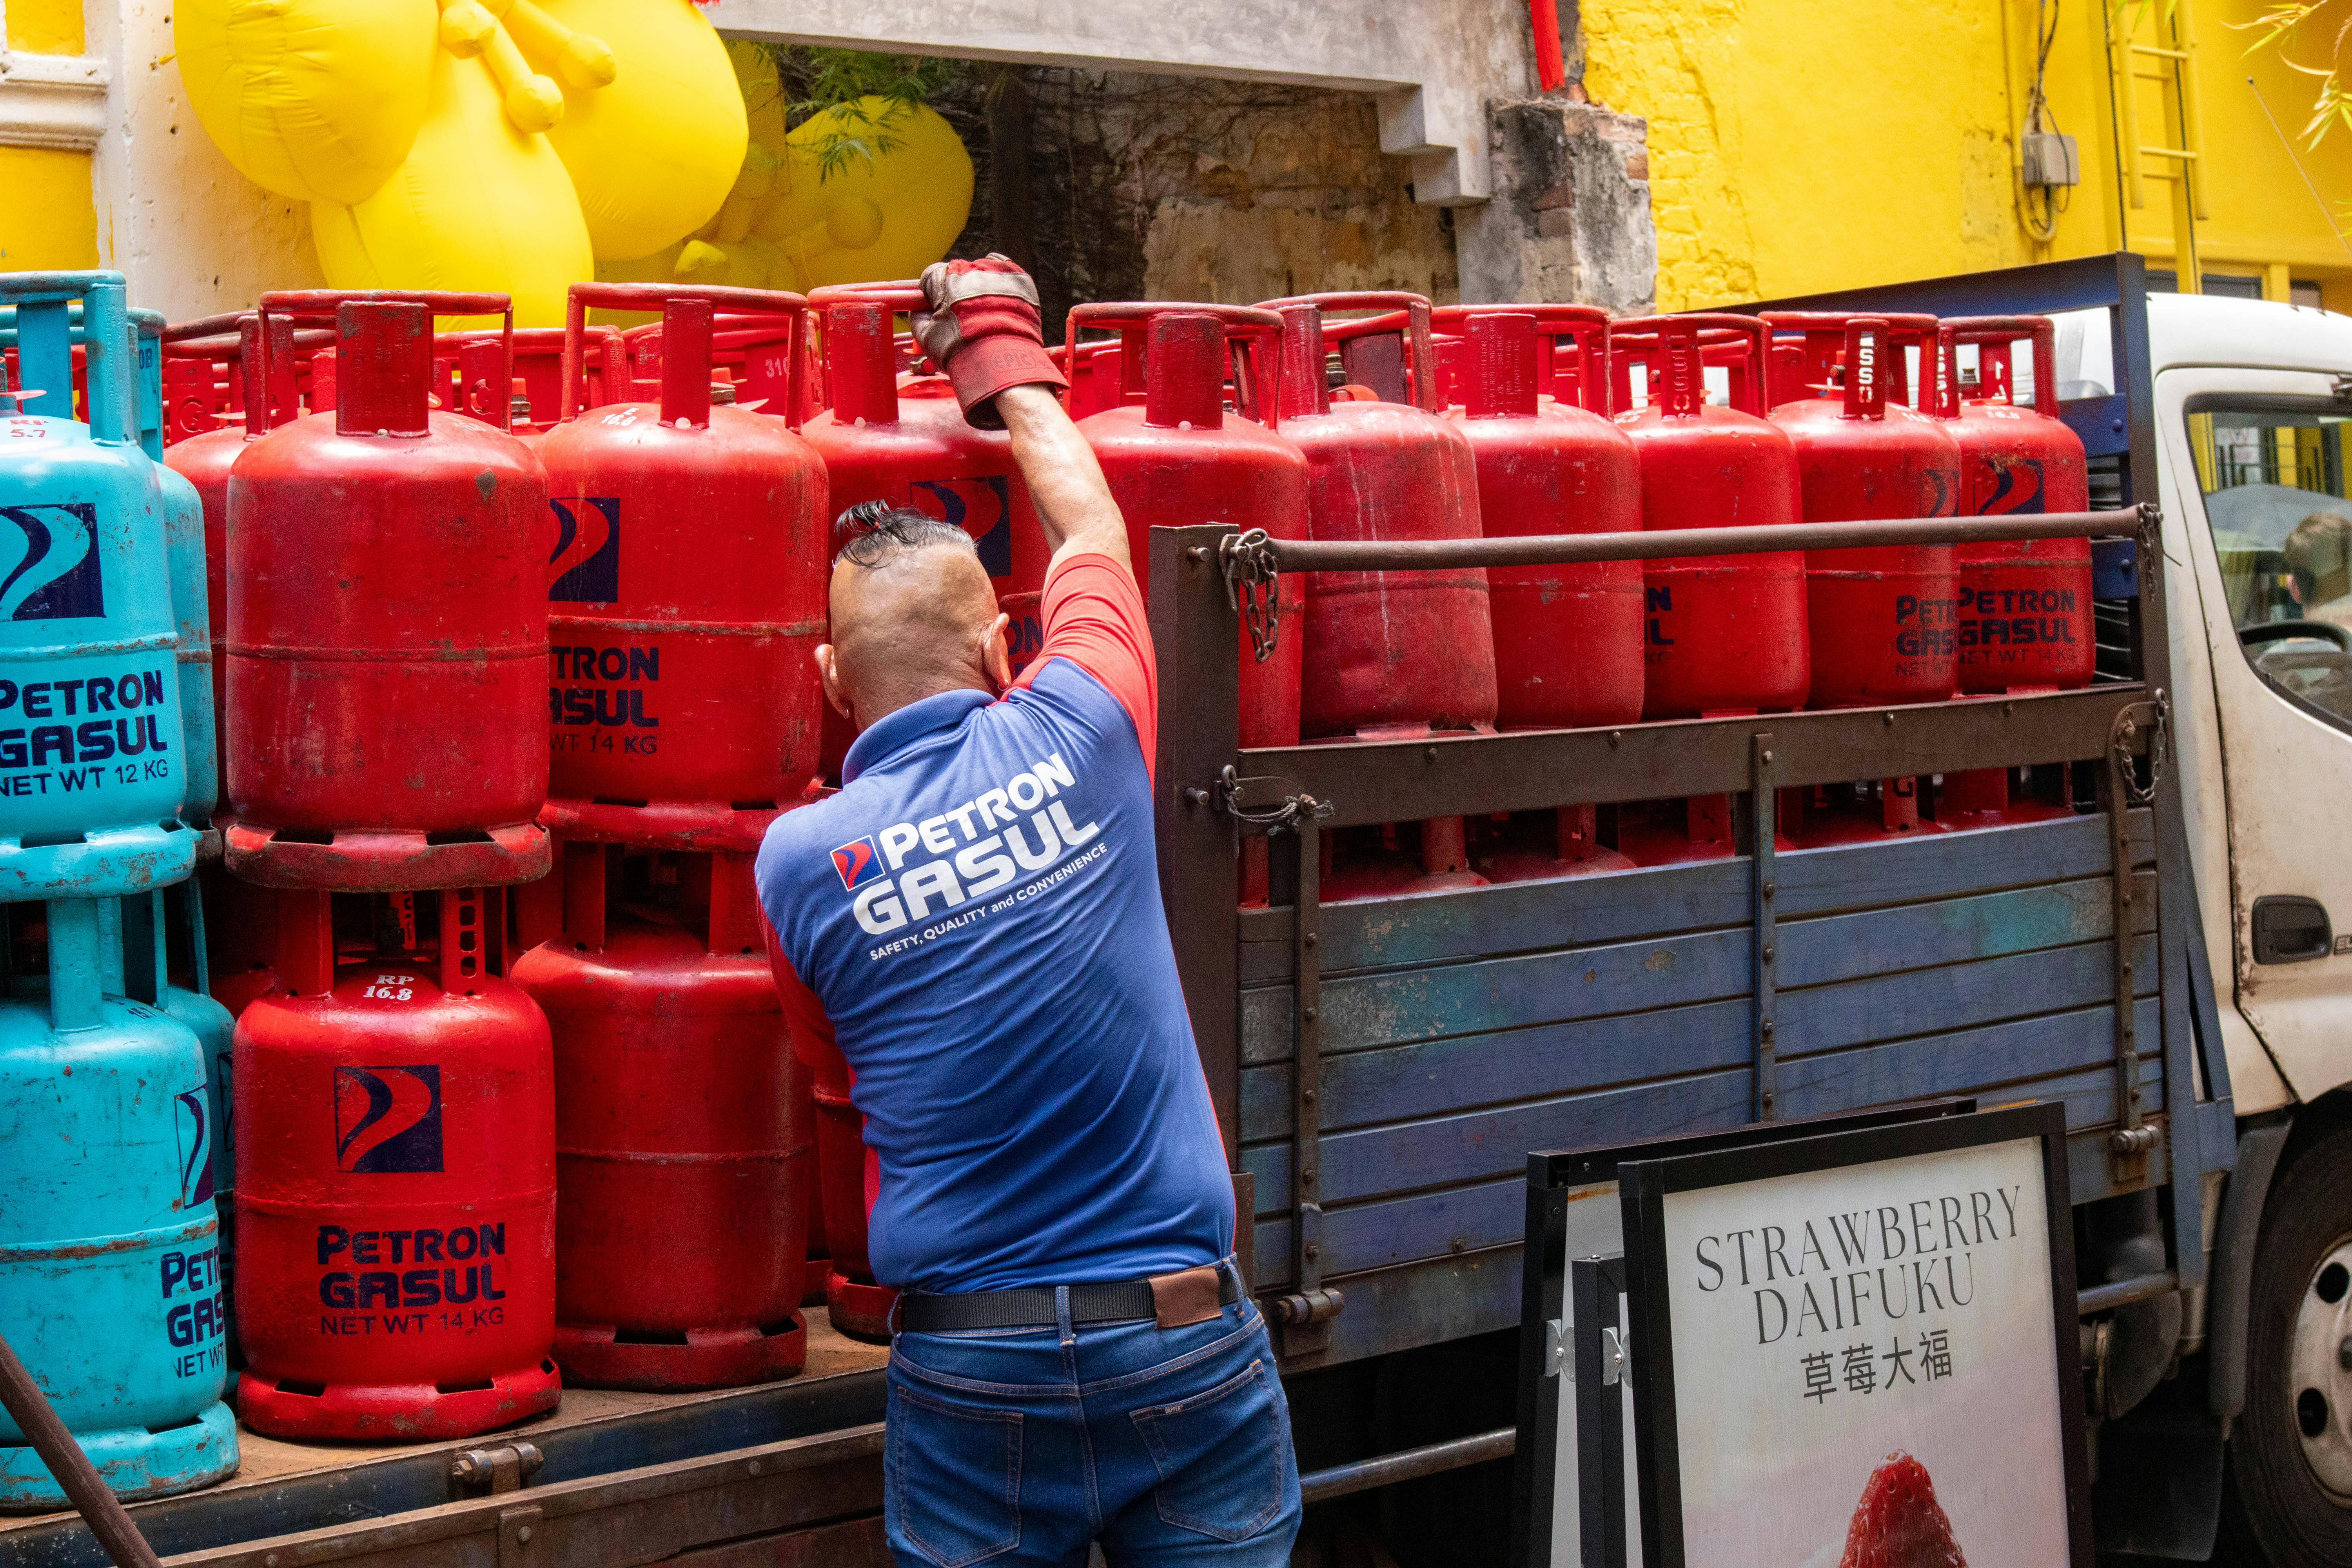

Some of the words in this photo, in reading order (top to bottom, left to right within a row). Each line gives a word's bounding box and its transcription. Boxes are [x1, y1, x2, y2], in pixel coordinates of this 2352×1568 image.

[10, 429, 46, 438] 5.7
[601, 414, 637, 426] 16.8
[1896, 629, 1959, 656] GAS
[1999, 649, 2029, 663] WT
[549, 646, 659, 681] TRON
[549, 688, 659, 727] SUL
[0, 714, 168, 768] GASUL
[589, 735, 614, 753] 14
[624, 735, 658, 755] KG
[58, 767, 106, 793] WT
[115, 764, 138, 784] 12
[145, 759, 169, 781] KG
[879, 752, 1076, 871] PETRON
[853, 800, 1100, 935] GASUL
[870, 934, 924, 961] SAFETY,
[924, 906, 986, 940] QUALITY
[991, 895, 1015, 913] and
[1016, 842, 1108, 901] CONVENIENCE
[376, 975, 414, 985] RP
[317, 1222, 505, 1265] PETRON
[1695, 1185, 2021, 1292] STRAWBERRY
[319, 1263, 505, 1308] GASUL
[1753, 1252, 1973, 1345] DAIFUKU
[167, 1291, 225, 1347] GAS
[321, 1315, 376, 1335] NET
[383, 1313, 429, 1334] WT
[439, 1312, 464, 1330] 14
[473, 1307, 504, 1327] KG
[1800, 1329, 1953, 1404] 草莓大福
[1165, 1405, 1181, 1414] DAPPER
